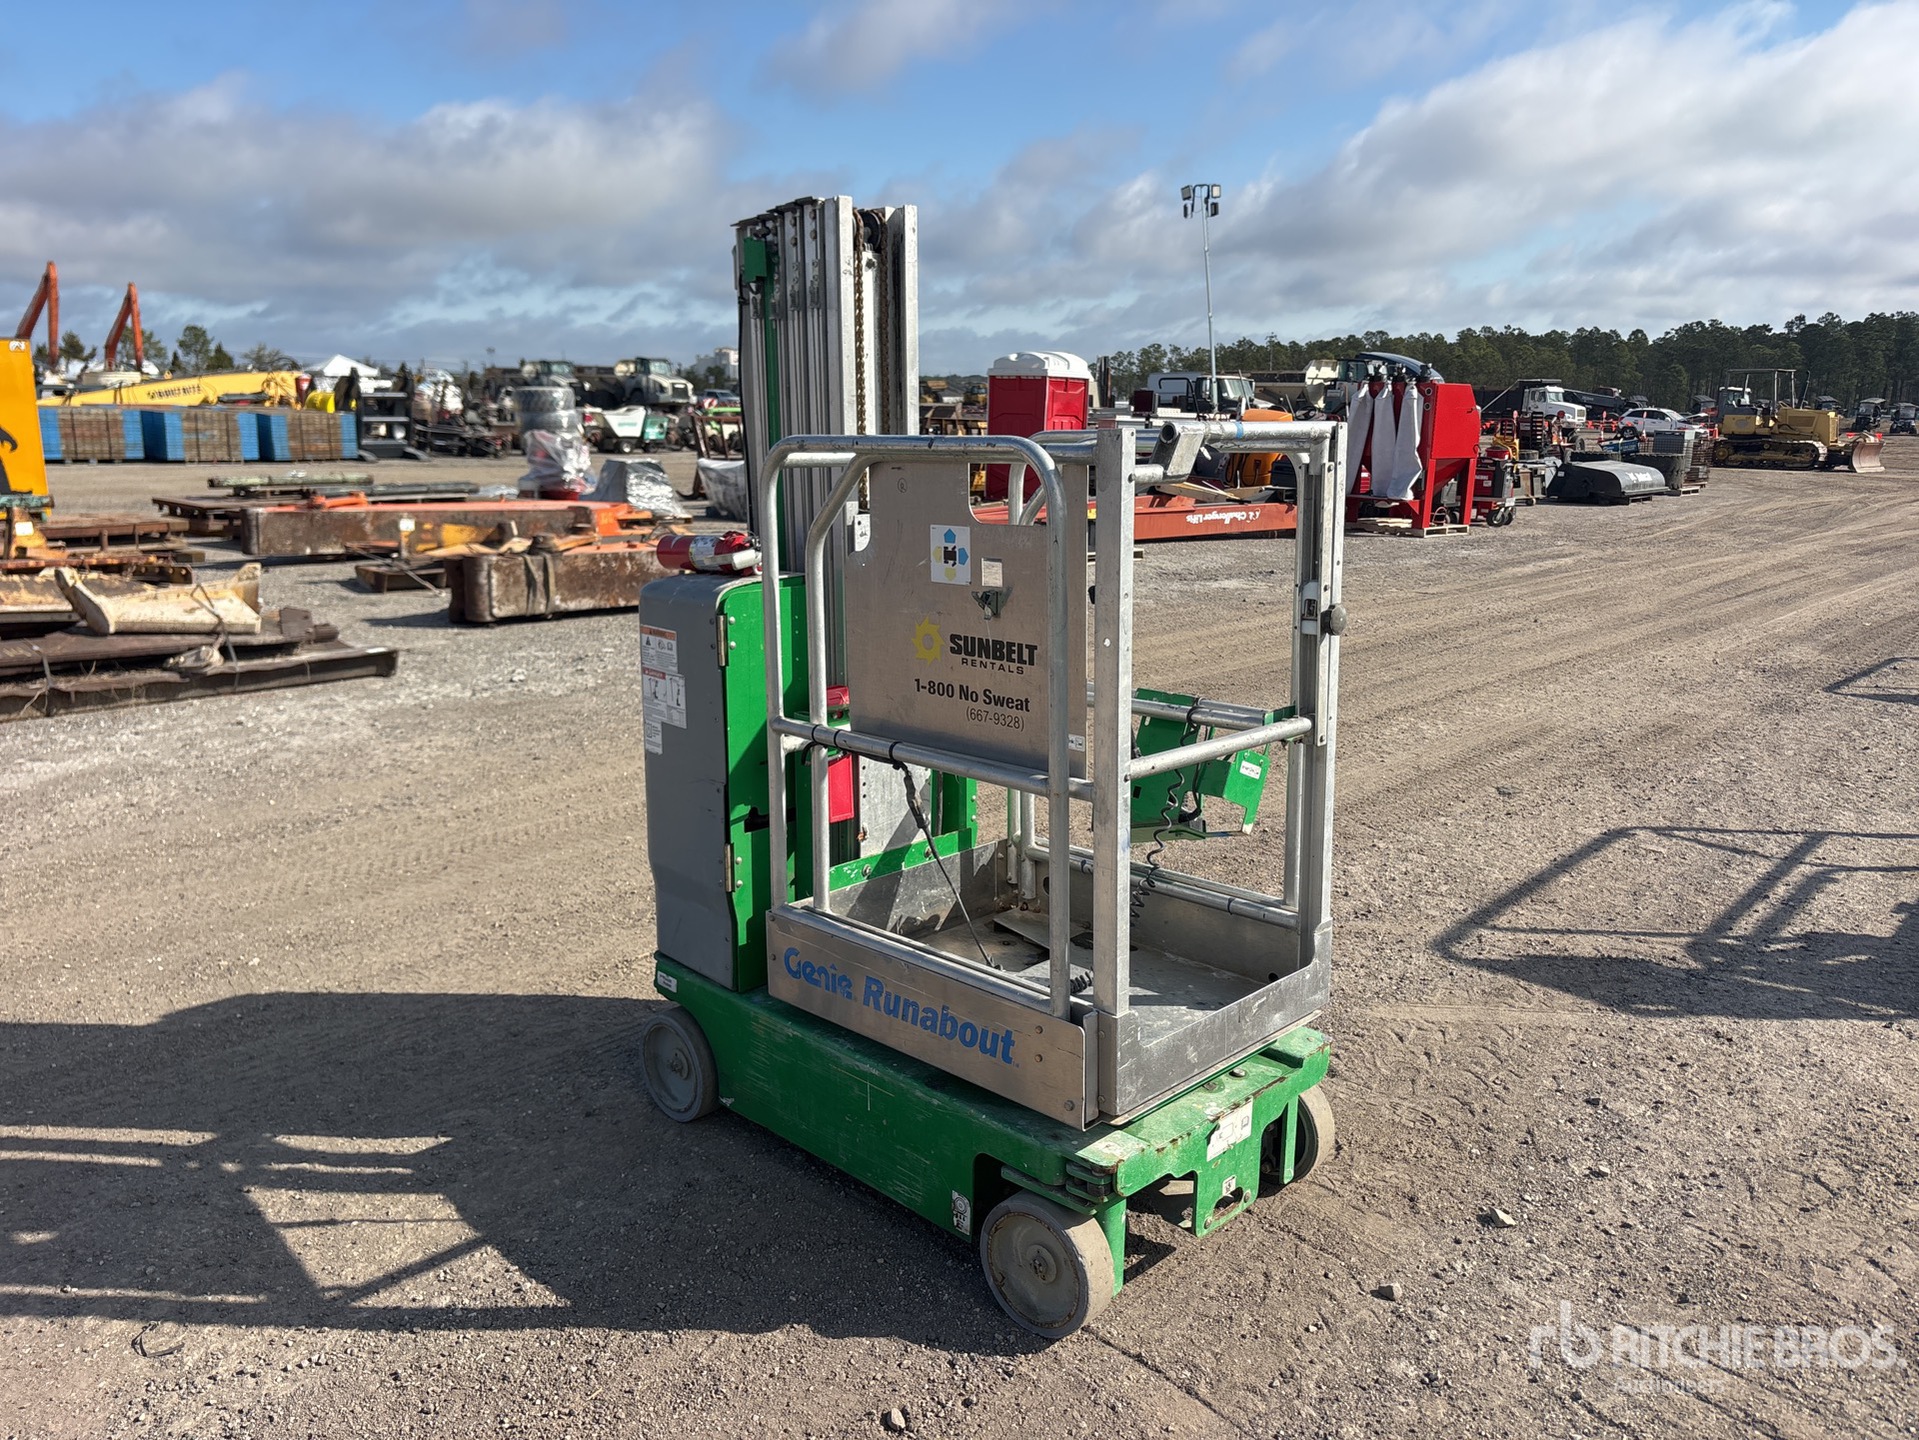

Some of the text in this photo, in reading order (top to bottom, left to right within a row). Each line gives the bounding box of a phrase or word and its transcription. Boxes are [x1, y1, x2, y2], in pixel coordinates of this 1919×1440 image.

[950, 633, 1038, 666] SUNBELT
[961, 657, 1025, 675] RENTALS
[914, 678, 1031, 712] 1-800 No Sweat
[966, 706, 1025, 732] (667-9328)
[783, 946, 1016, 1065] Genie Runabout
